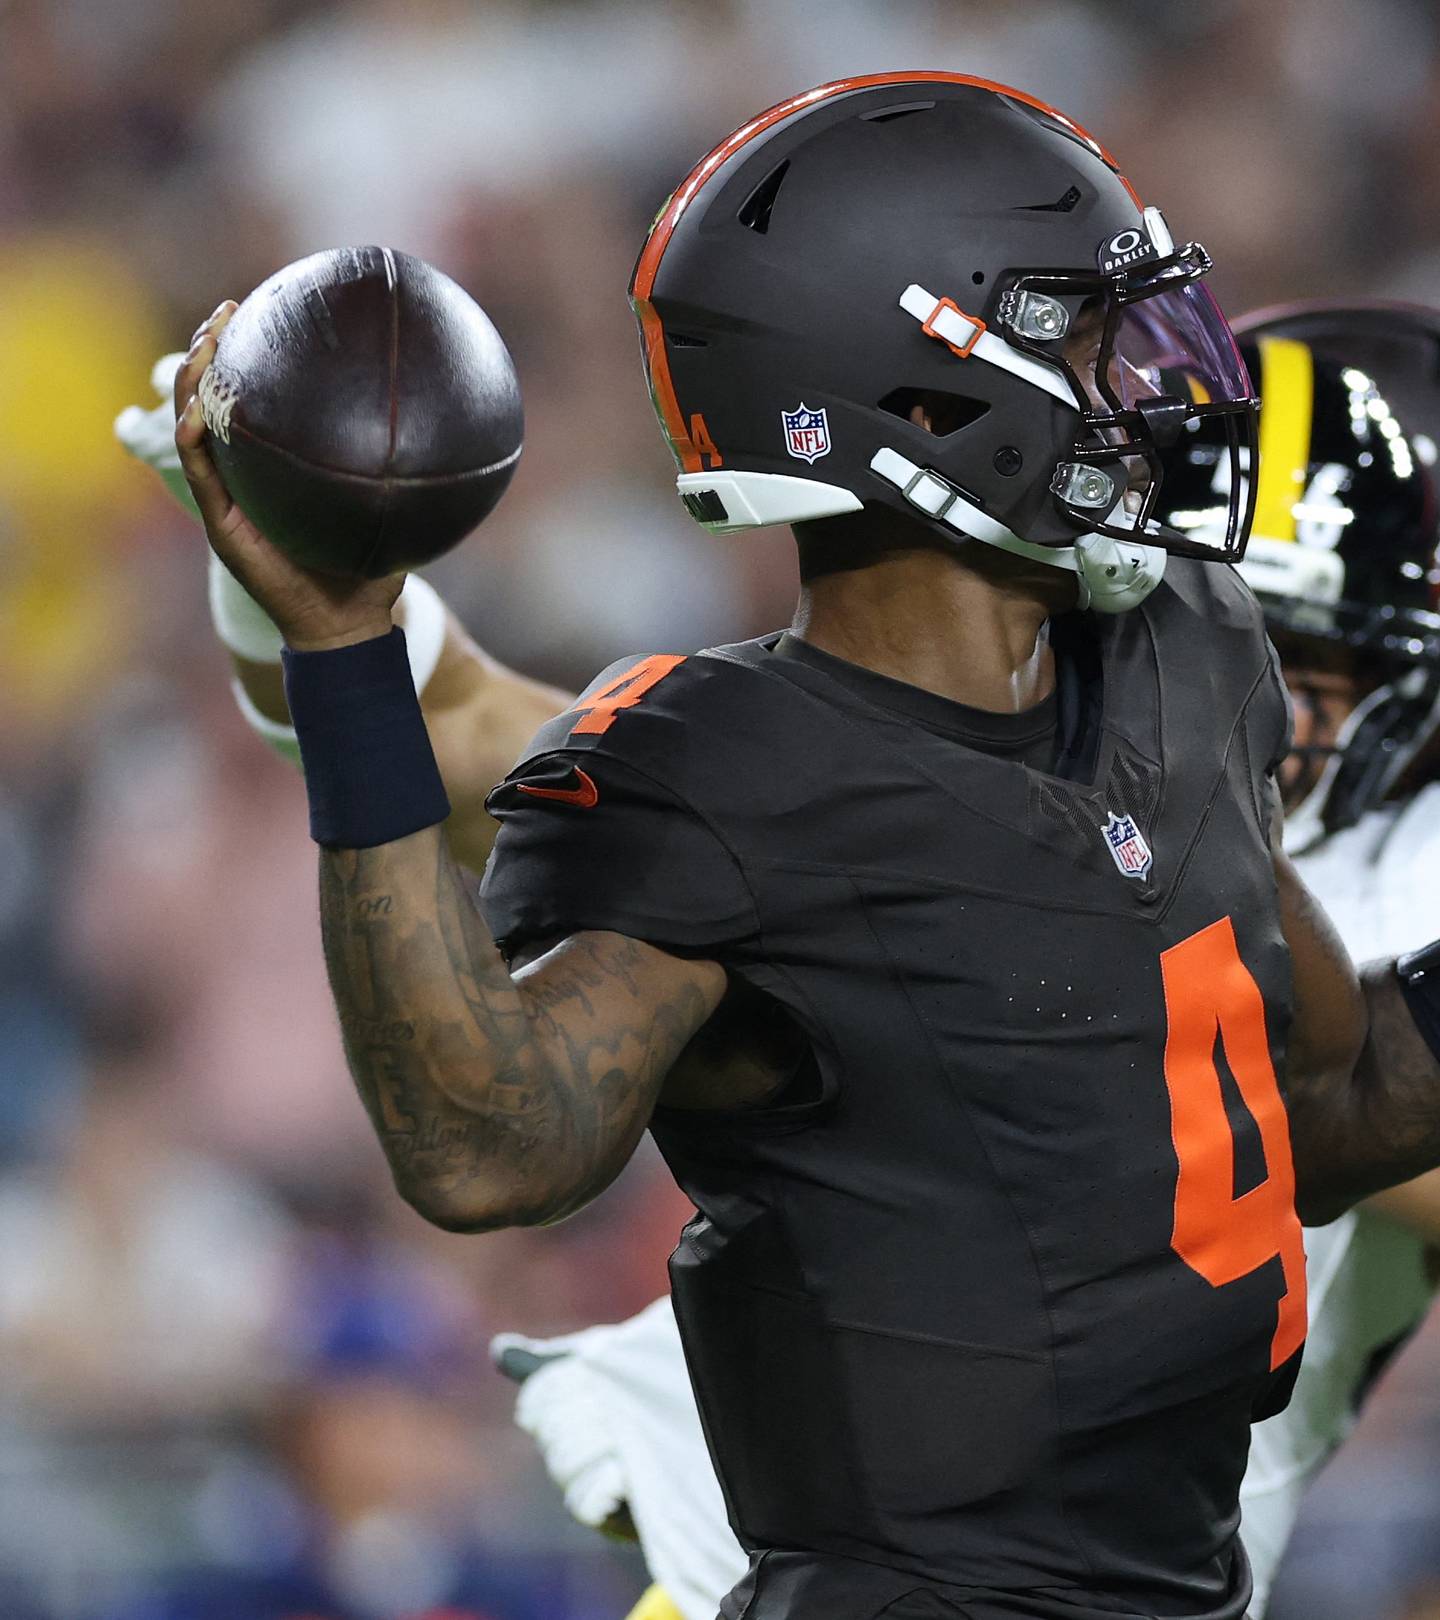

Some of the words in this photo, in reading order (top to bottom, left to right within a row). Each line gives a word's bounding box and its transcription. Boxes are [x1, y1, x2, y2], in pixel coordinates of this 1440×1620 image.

[1104, 243, 1151, 272] OAKLEY
[790, 429, 825, 454] NFL
[571, 654, 688, 735] 4
[1118, 839, 1147, 869] NFL
[1160, 915, 1308, 1374] 4
